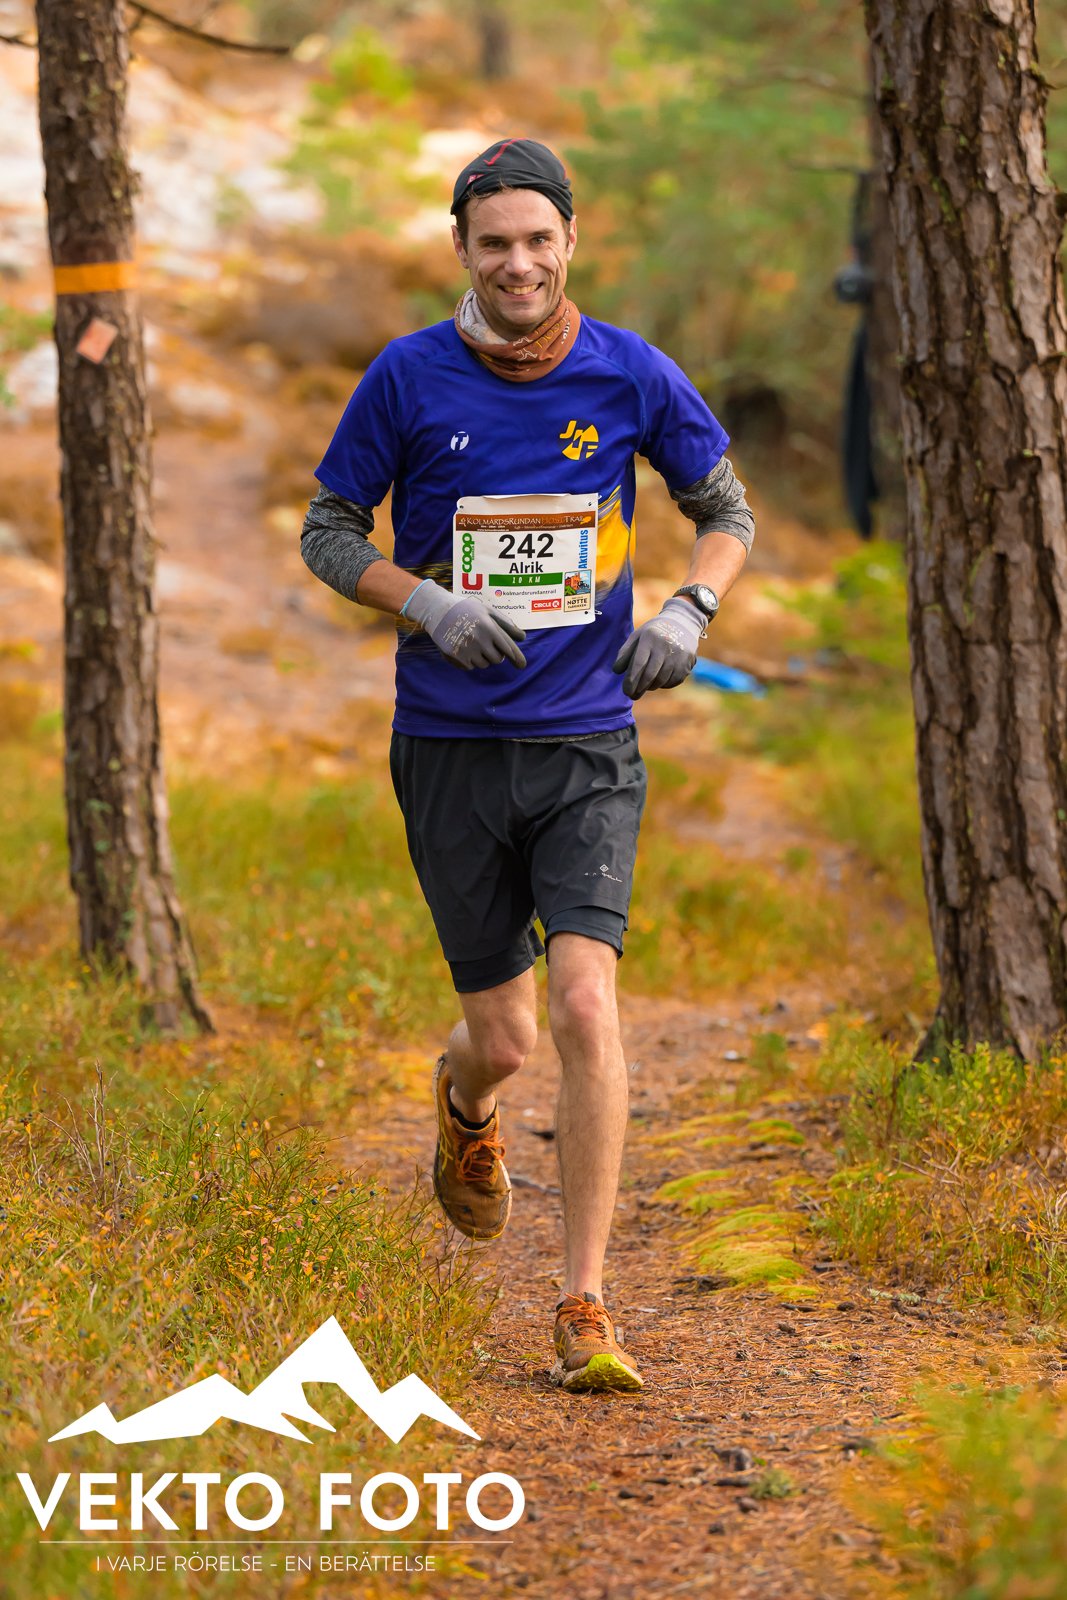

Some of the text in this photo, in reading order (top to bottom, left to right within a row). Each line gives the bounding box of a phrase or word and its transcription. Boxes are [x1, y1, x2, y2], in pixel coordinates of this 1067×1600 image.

[462, 532, 475, 573] coop
[498, 533, 554, 559] 242
[578, 529, 589, 569] Aktivitus
[509, 561, 544, 574] Alrik
[512, 576, 541, 584] 10 KM
